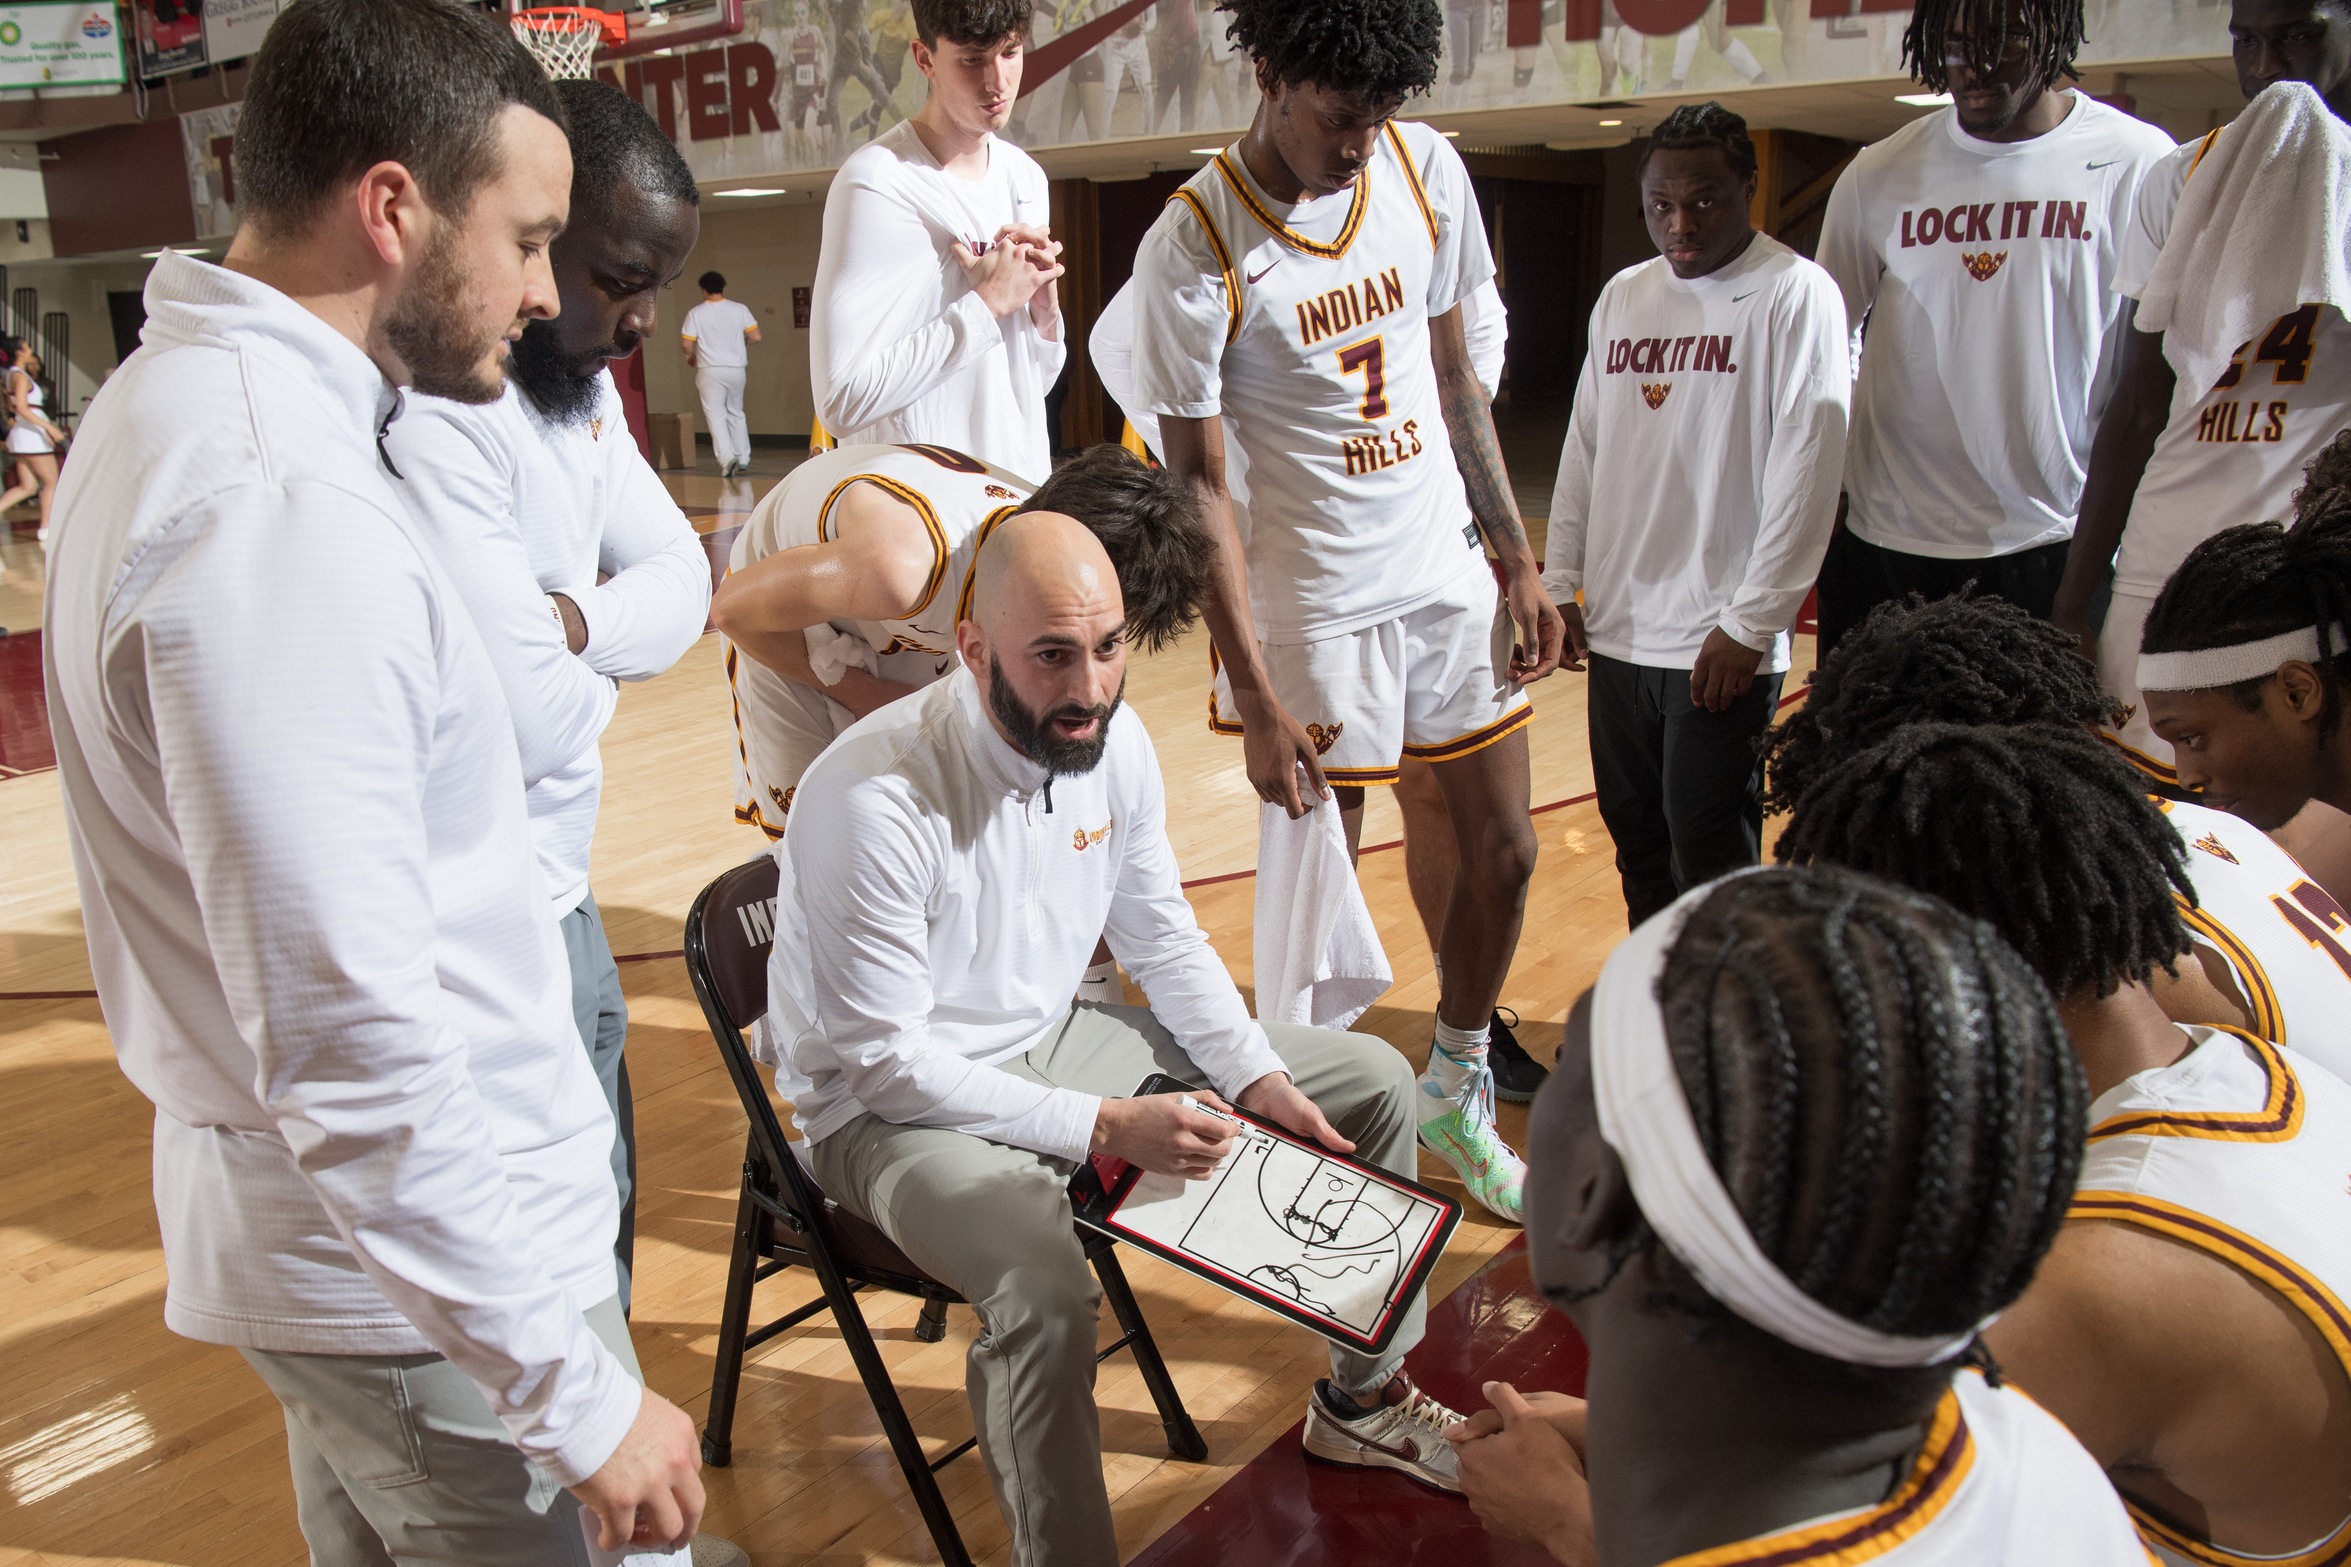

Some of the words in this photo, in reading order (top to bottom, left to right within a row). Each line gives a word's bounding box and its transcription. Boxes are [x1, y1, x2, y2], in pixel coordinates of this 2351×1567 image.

[0, 54, 32, 62] Trusted
[34, 53, 47, 61] for
[71, 51, 87, 59] 100
[30, 41, 61, 50] Quality
[1901, 203, 1996, 248] LOCK
[2000, 201, 2038, 240] IT
[2041, 200, 2092, 241] IN.
[1296, 266, 1404, 346] INDIAN
[1606, 338, 1672, 374] LOCK
[1669, 336, 1696, 372] IT
[1693, 335, 1737, 373] IN.
[1335, 334, 1391, 422] 7
[2197, 401, 2288, 442] HILLS
[1342, 419, 1422, 477] HILLS
